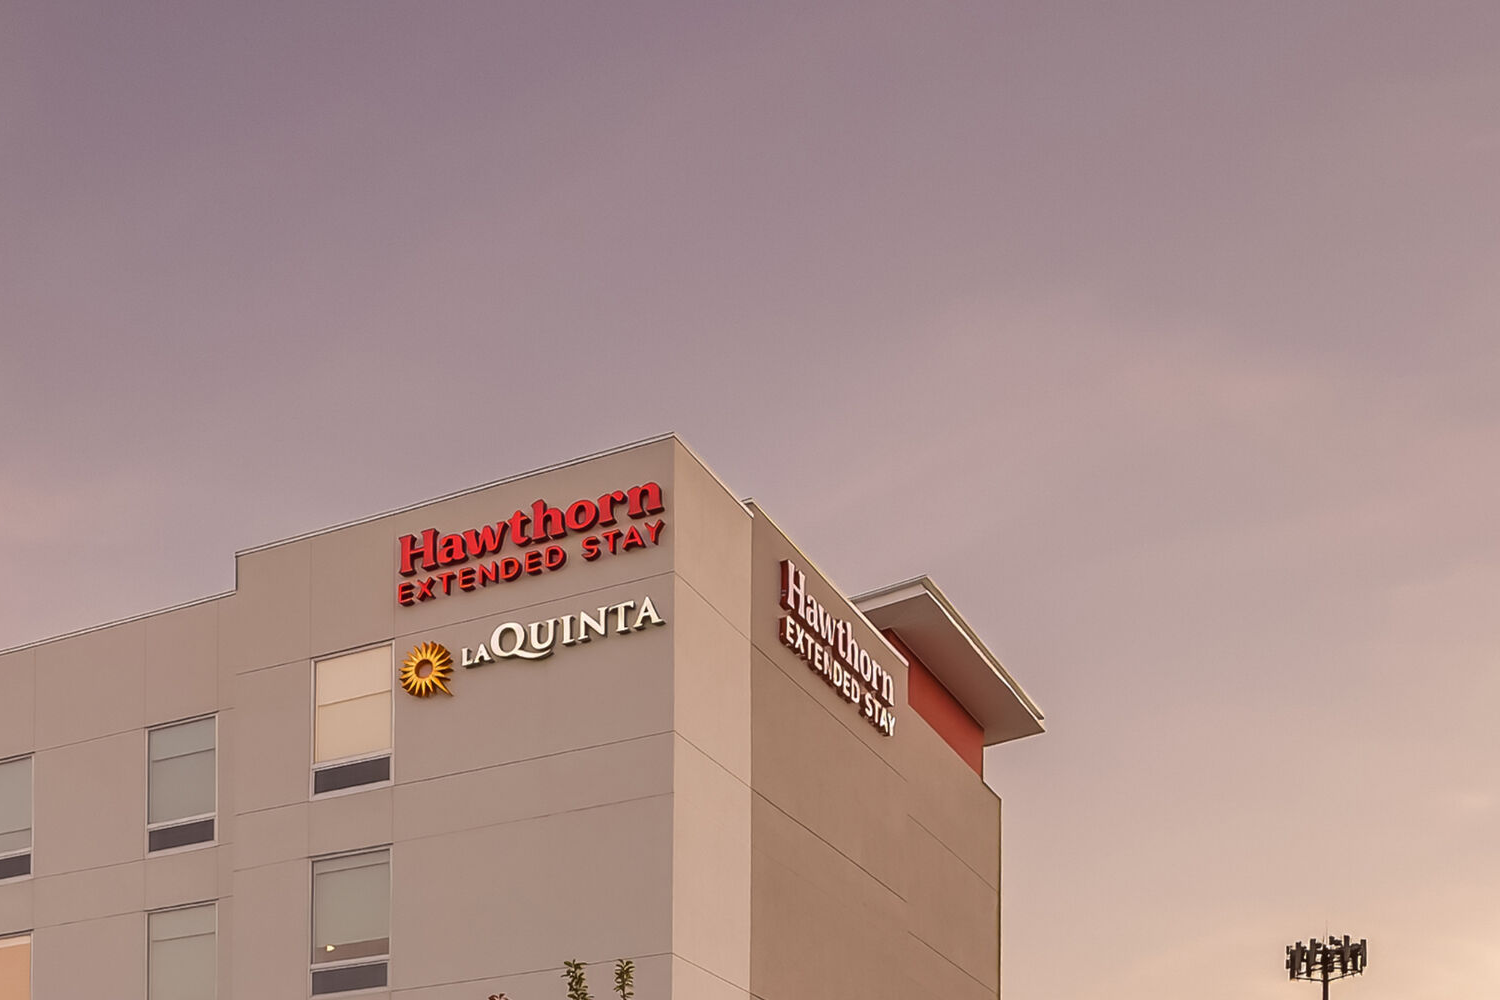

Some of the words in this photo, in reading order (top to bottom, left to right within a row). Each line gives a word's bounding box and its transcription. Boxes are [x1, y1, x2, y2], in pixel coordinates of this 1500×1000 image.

[397, 545, 567, 606] EXTENDED
[581, 519, 666, 562] STAY
[398, 481, 664, 576] Hawthorn
[490, 596, 666, 660] QUINTA
[786, 559, 895, 707] Hawthorn
[786, 615, 861, 704] EXTENDED
[864, 692, 896, 737] STAY
